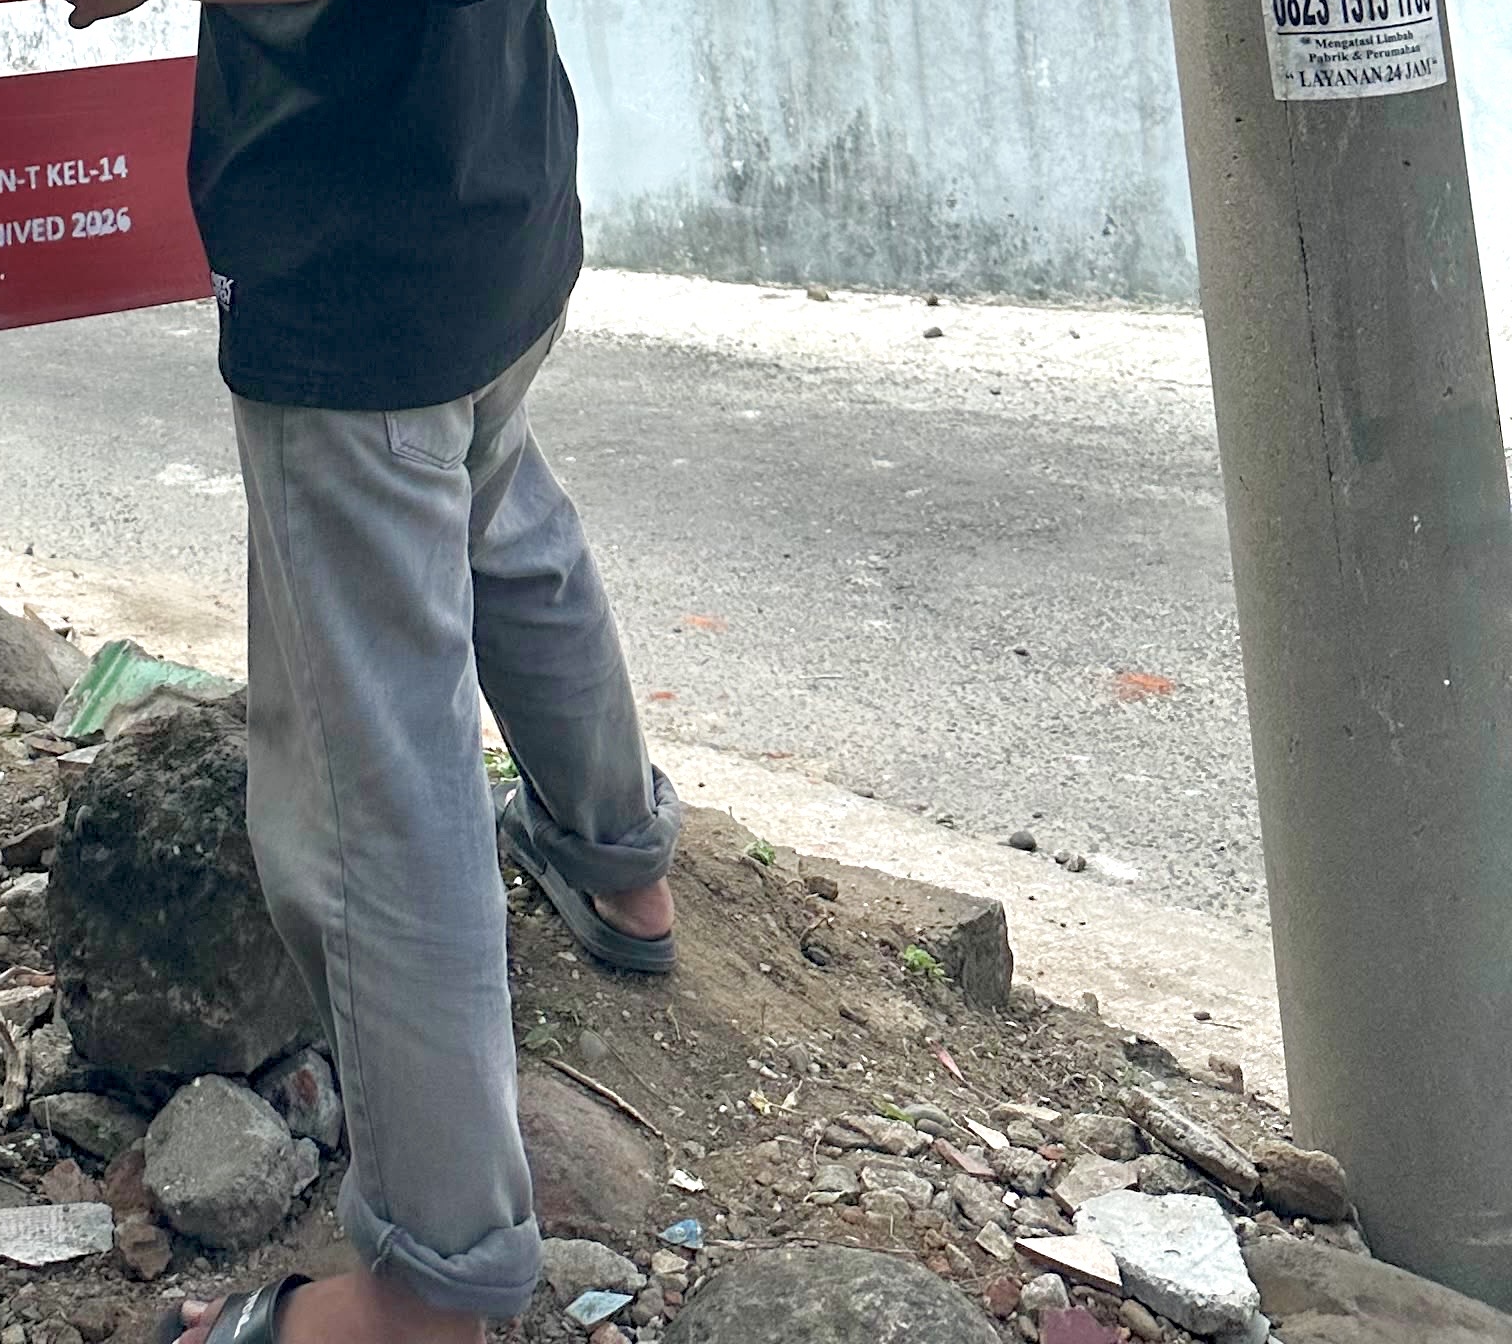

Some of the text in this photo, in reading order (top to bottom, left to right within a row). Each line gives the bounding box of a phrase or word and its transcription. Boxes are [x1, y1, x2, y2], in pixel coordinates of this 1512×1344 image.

[1315, 35, 1374, 51] Mengatasi
[1376, 30, 1414, 44] Limbah
[1309, 51, 1349, 63] Pabrik
[1352, 50, 1362, 61] &
[1299, 67, 1382, 88] LAYANAN
[1386, 64, 1402, 82] 24
[46, 155, 129, 188] KEL-14
[71, 206, 132, 238] 2026
